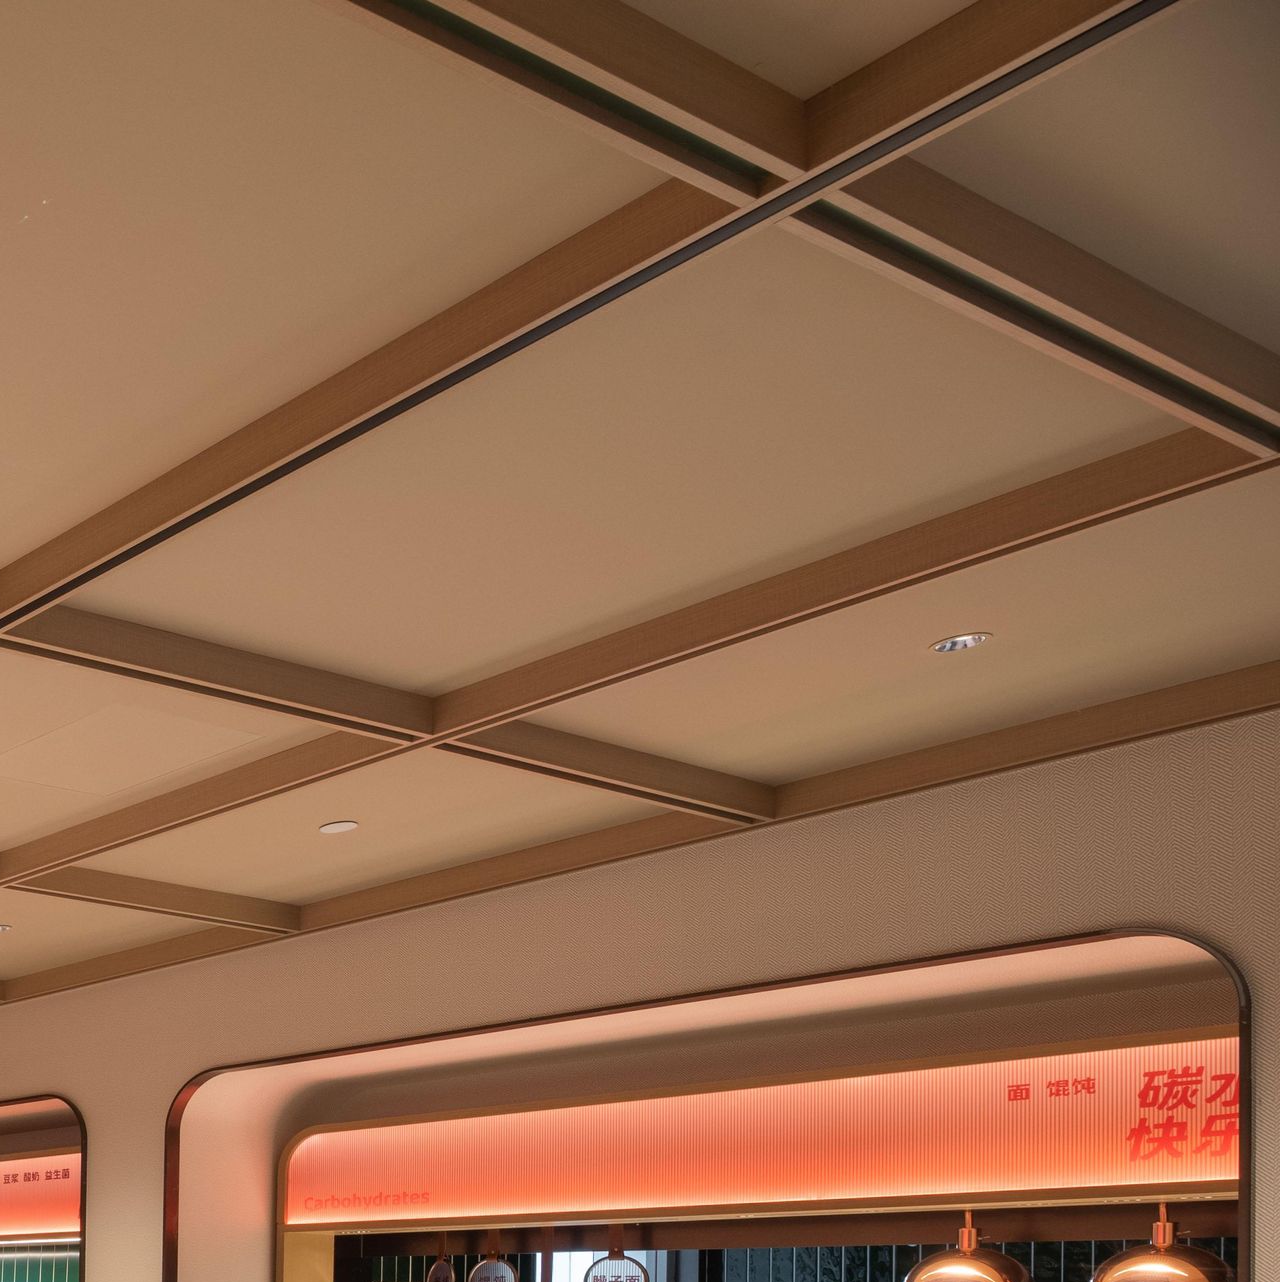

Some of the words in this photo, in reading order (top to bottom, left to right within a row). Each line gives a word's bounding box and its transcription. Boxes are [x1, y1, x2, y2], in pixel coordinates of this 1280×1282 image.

[1007, 1083, 1031, 1101] 面
[1046, 1076, 1096, 1097] 馄饨
[1126, 1112, 1240, 1162] 快乐
[45, 1168, 70, 1181] 益生菌
[304, 1191, 430, 1211] Carbohydrates
